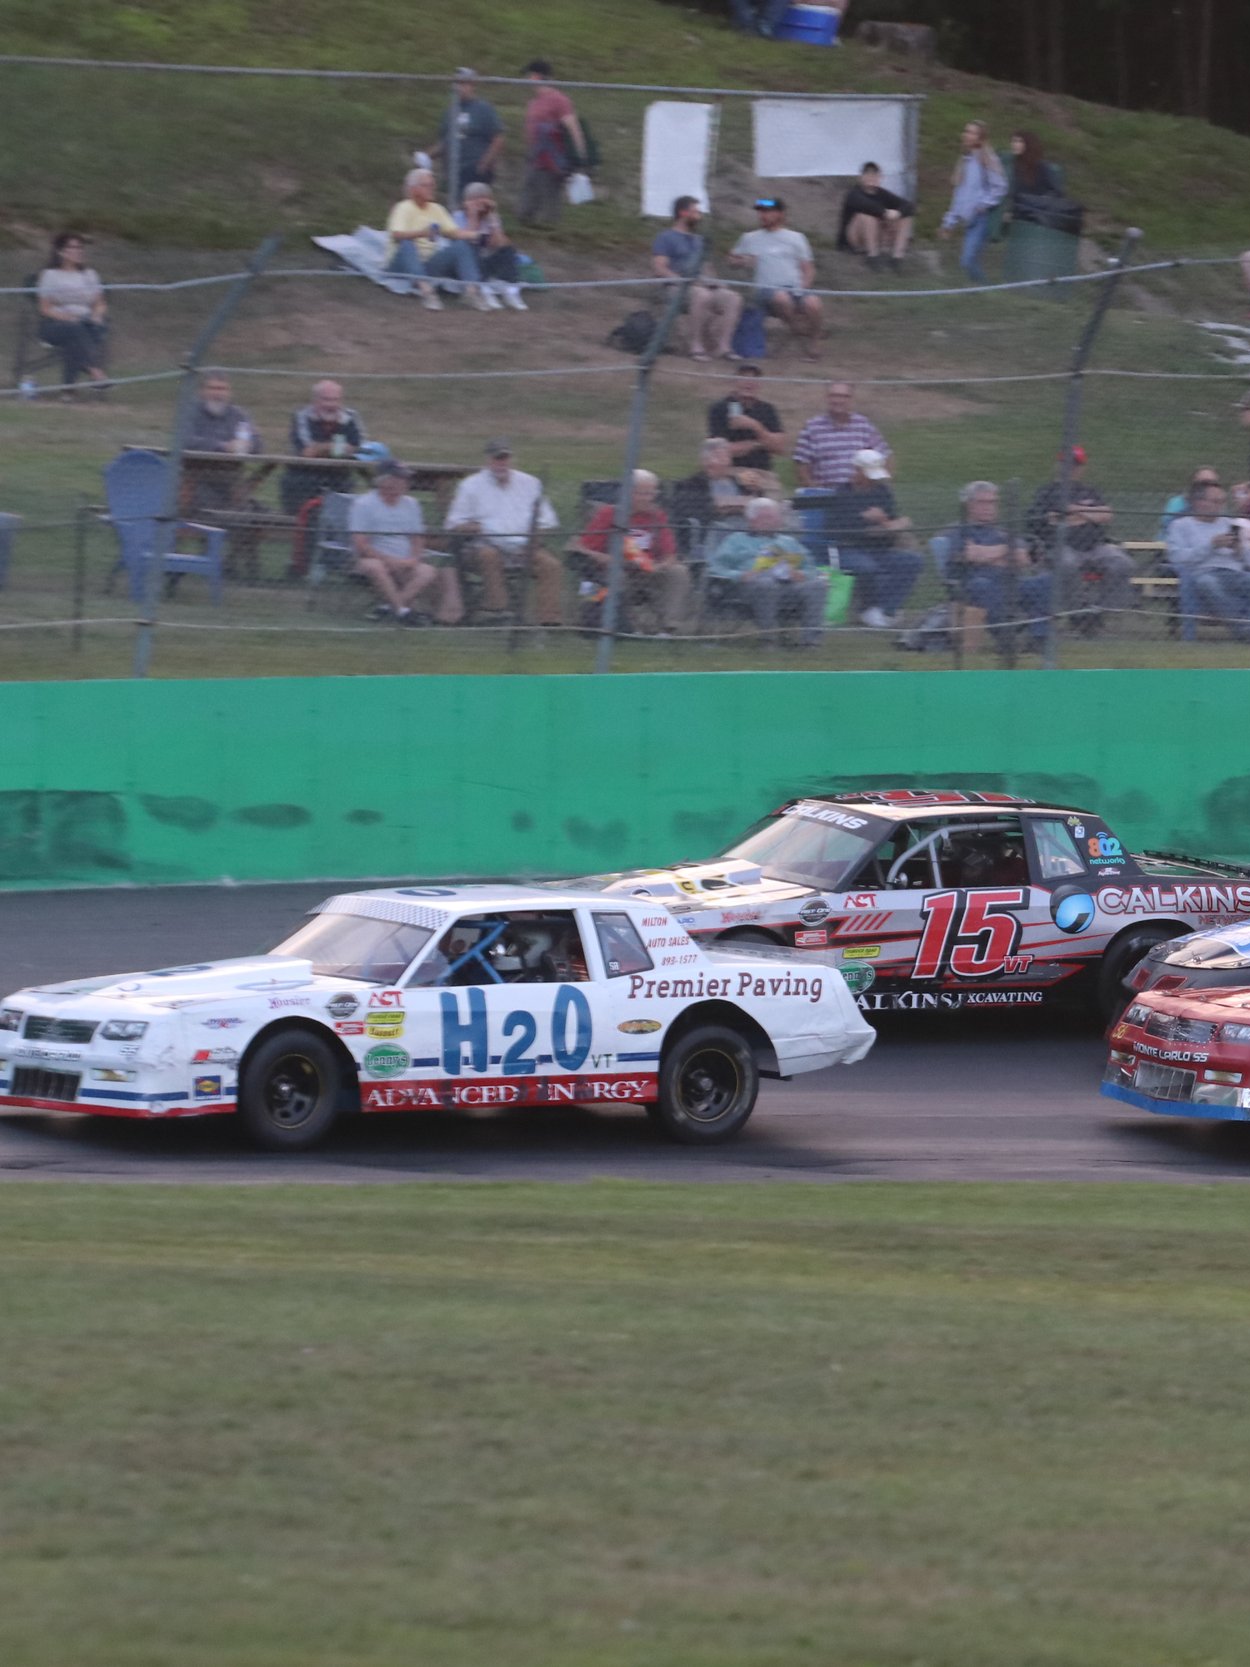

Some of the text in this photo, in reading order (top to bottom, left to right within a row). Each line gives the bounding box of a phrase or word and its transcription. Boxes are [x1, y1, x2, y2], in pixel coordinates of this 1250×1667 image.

[783, 804, 868, 829] CALKINS
[1088, 837, 1123, 857] 802
[844, 894, 877, 908] ACT
[641, 917, 668, 927] MILTON
[648, 936, 690, 948] AUTO SALES
[911, 888, 1034, 980] 15 VT
[628, 971, 823, 1002] Premier Paving
[368, 991, 404, 1008] ACT
[855, 991, 951, 1010] ALKINS
[592, 1053, 613, 1069] VT
[1133, 1042, 1209, 1062] MONTE CARLO SS
